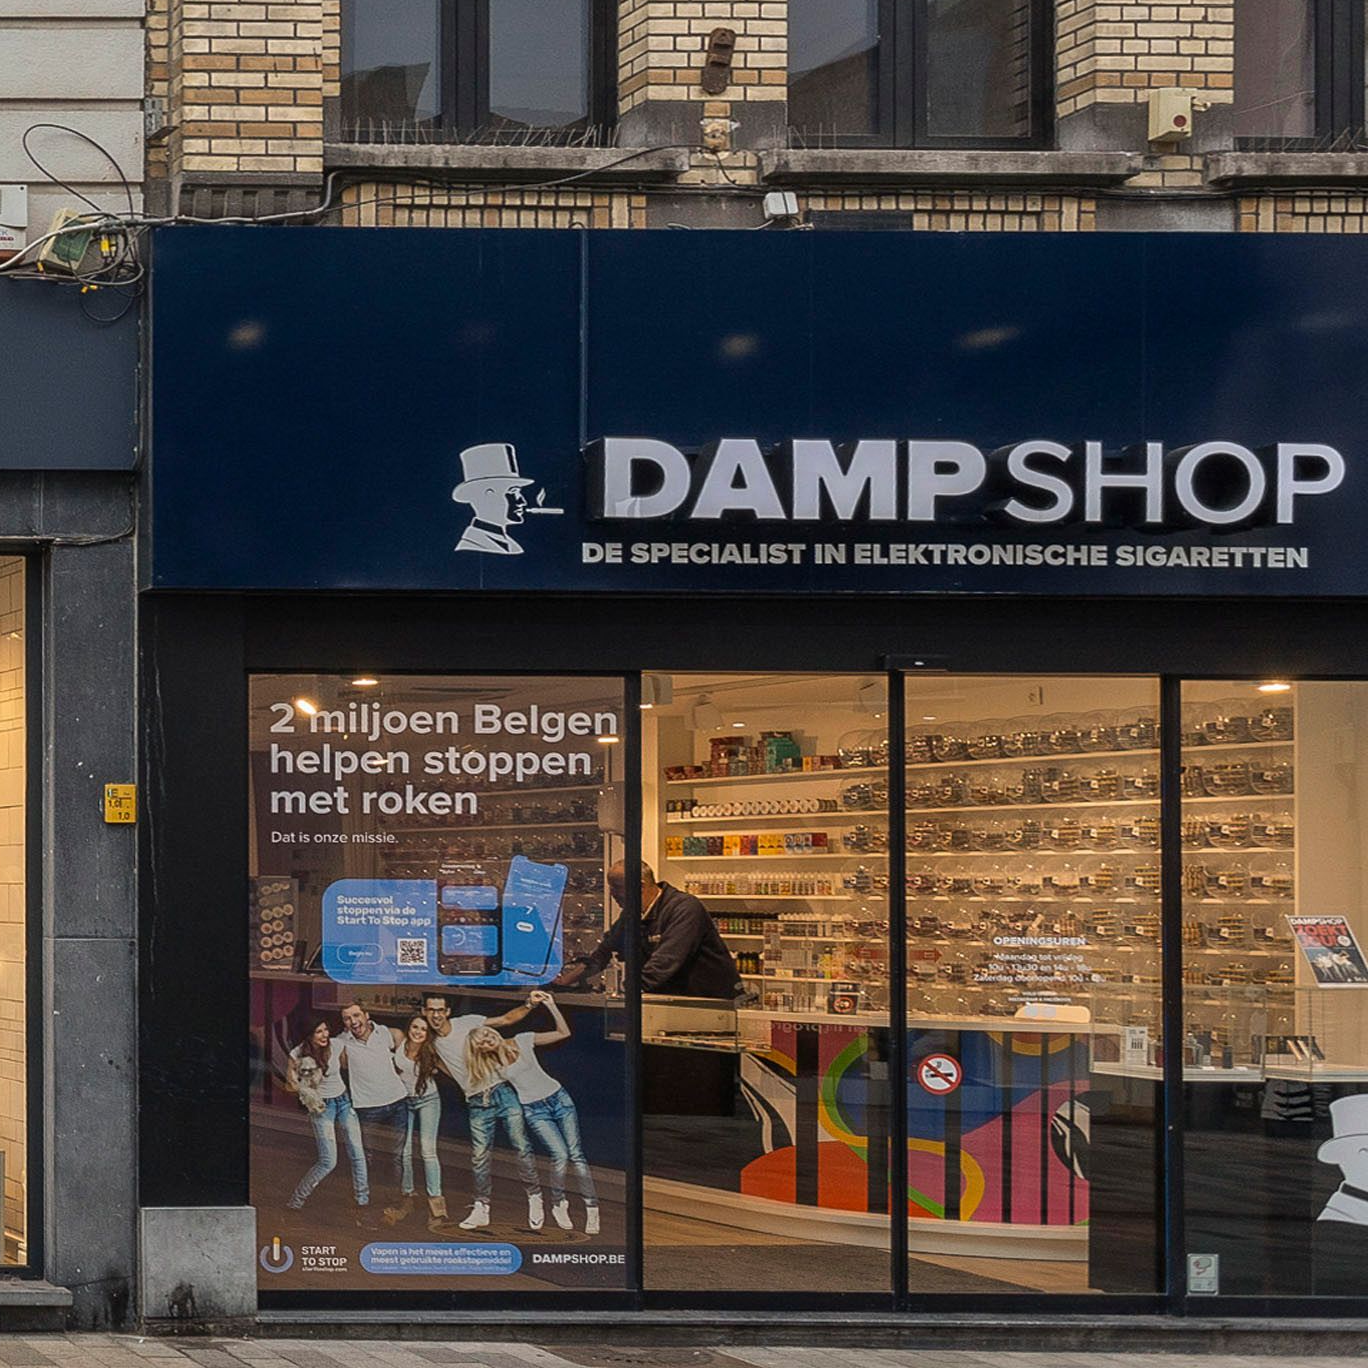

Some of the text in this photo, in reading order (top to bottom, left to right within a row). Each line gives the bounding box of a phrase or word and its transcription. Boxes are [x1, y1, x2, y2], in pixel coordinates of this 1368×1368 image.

[582, 542, 1309, 569] DE SPECIALIST IN ELEKTRONISCHE SIGARETTEN
[269, 702, 618, 744] 2 miljoen Belgen
[270, 744, 592, 782] helpen stoppen
[270, 784, 479, 815] met roken
[271, 831, 399, 844] Dat is onze missie.
[336, 895, 394, 905] Succesvol
[336, 906, 383, 916] stoppen
[336, 916, 432, 927] Start To Stop app
[993, 936, 1087, 946] OPENINGSUREN
[301, 1245, 336, 1255] START
[301, 1257, 348, 1267] TO STOP
[532, 1253, 625, 1265] DAMPSHOP.BE
